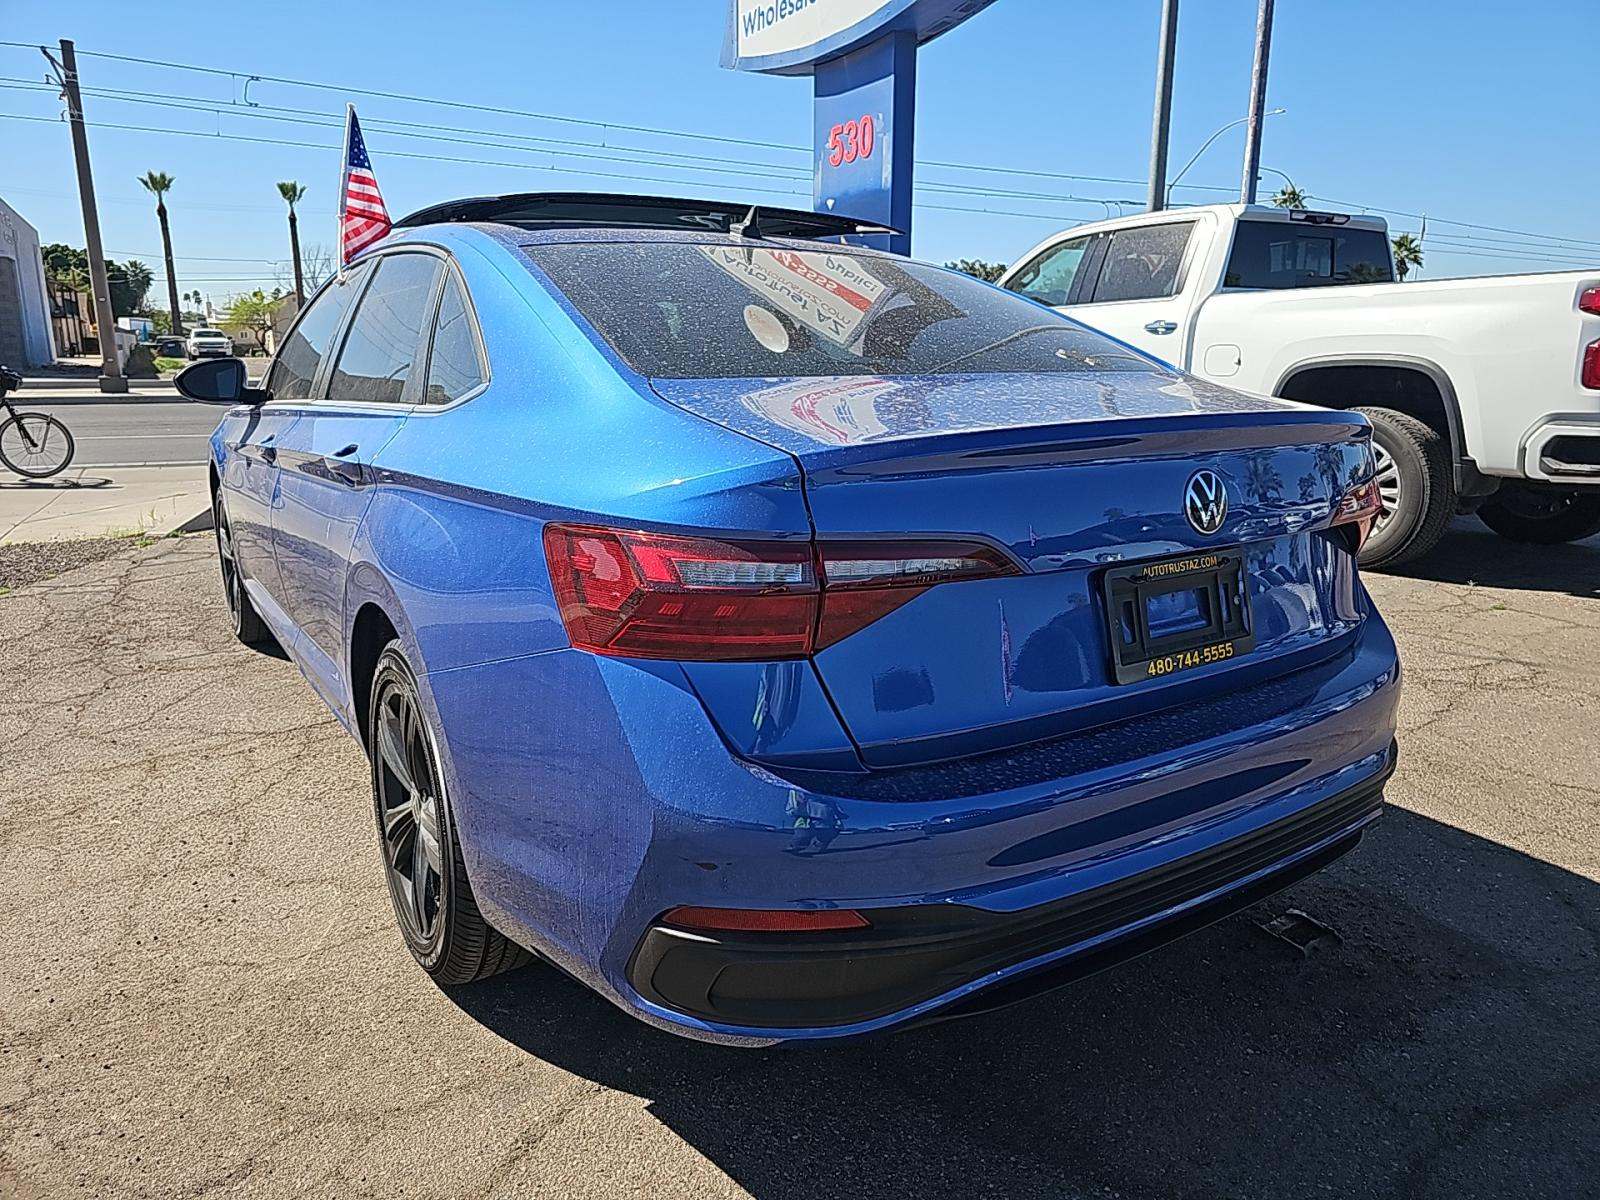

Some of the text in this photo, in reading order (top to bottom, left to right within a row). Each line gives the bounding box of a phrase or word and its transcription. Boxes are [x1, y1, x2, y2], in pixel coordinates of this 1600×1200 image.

[743, 0, 816, 37] Wholesa
[829, 115, 874, 167] 530
[1143, 556, 1218, 577] AUTOTRUSTAZ.COM
[1148, 642, 1234, 676] 480-744-5555
